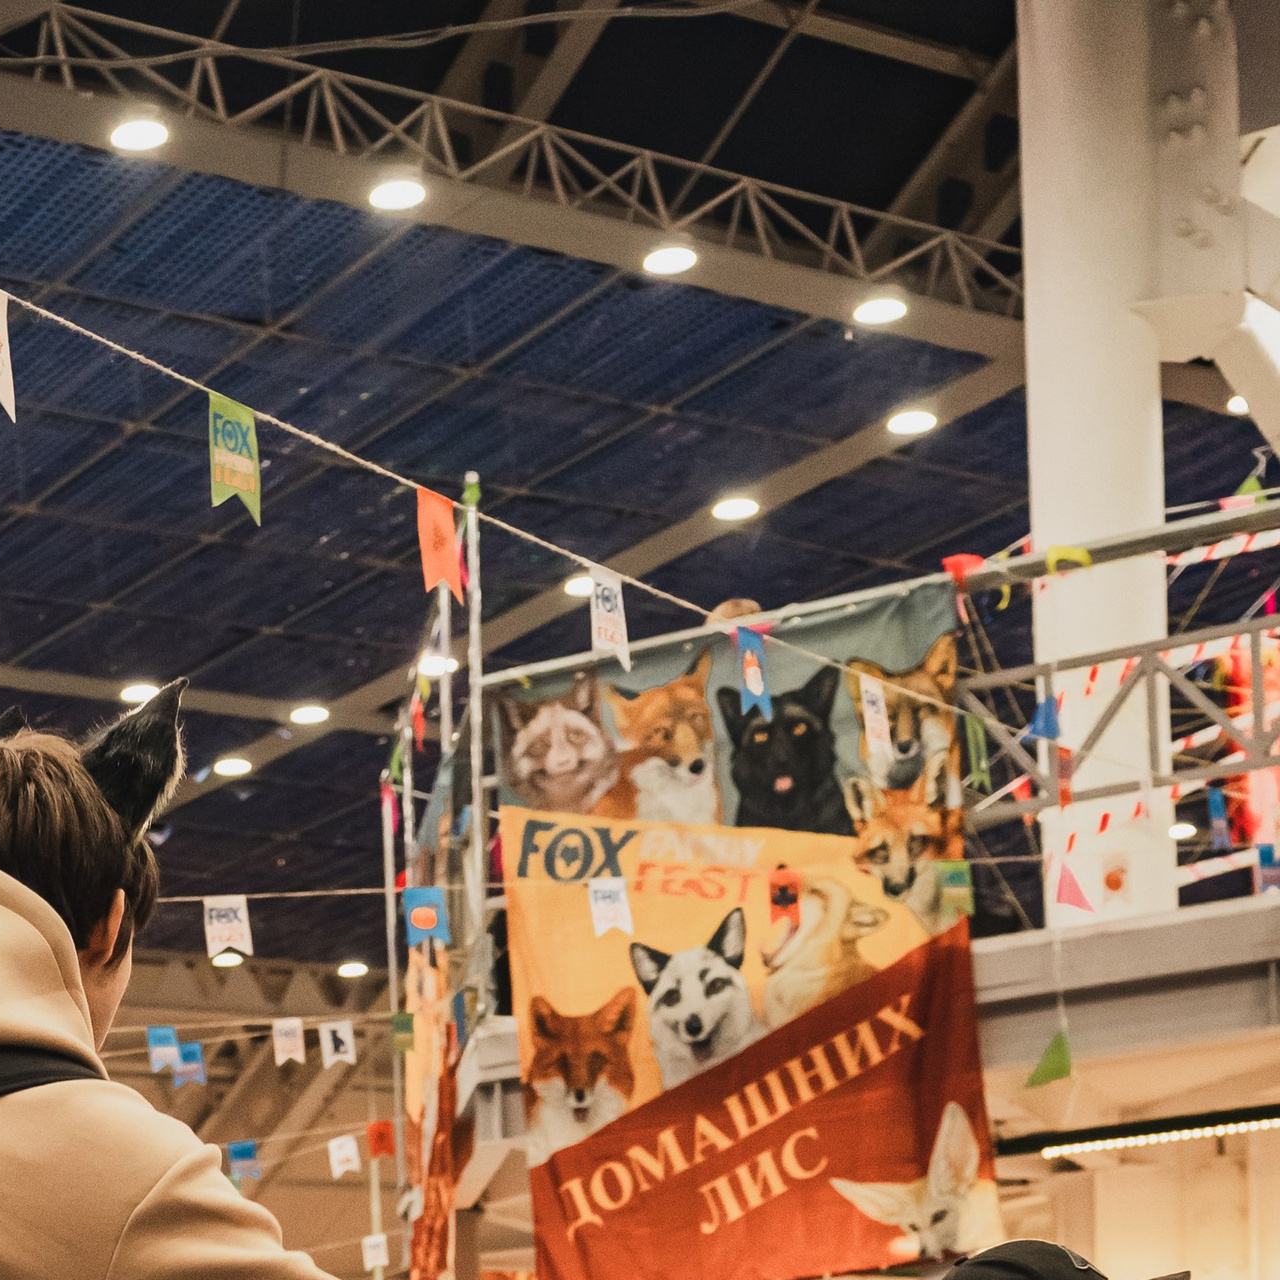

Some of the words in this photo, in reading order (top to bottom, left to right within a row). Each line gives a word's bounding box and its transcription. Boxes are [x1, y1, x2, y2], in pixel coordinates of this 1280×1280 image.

[213, 411, 254, 460] FOX
[517, 819, 639, 884] FOX
[633, 862, 762, 903] FEST
[560, 993, 925, 1241] ДОМАШНИХ
[698, 1126, 828, 1235] ЛИС
